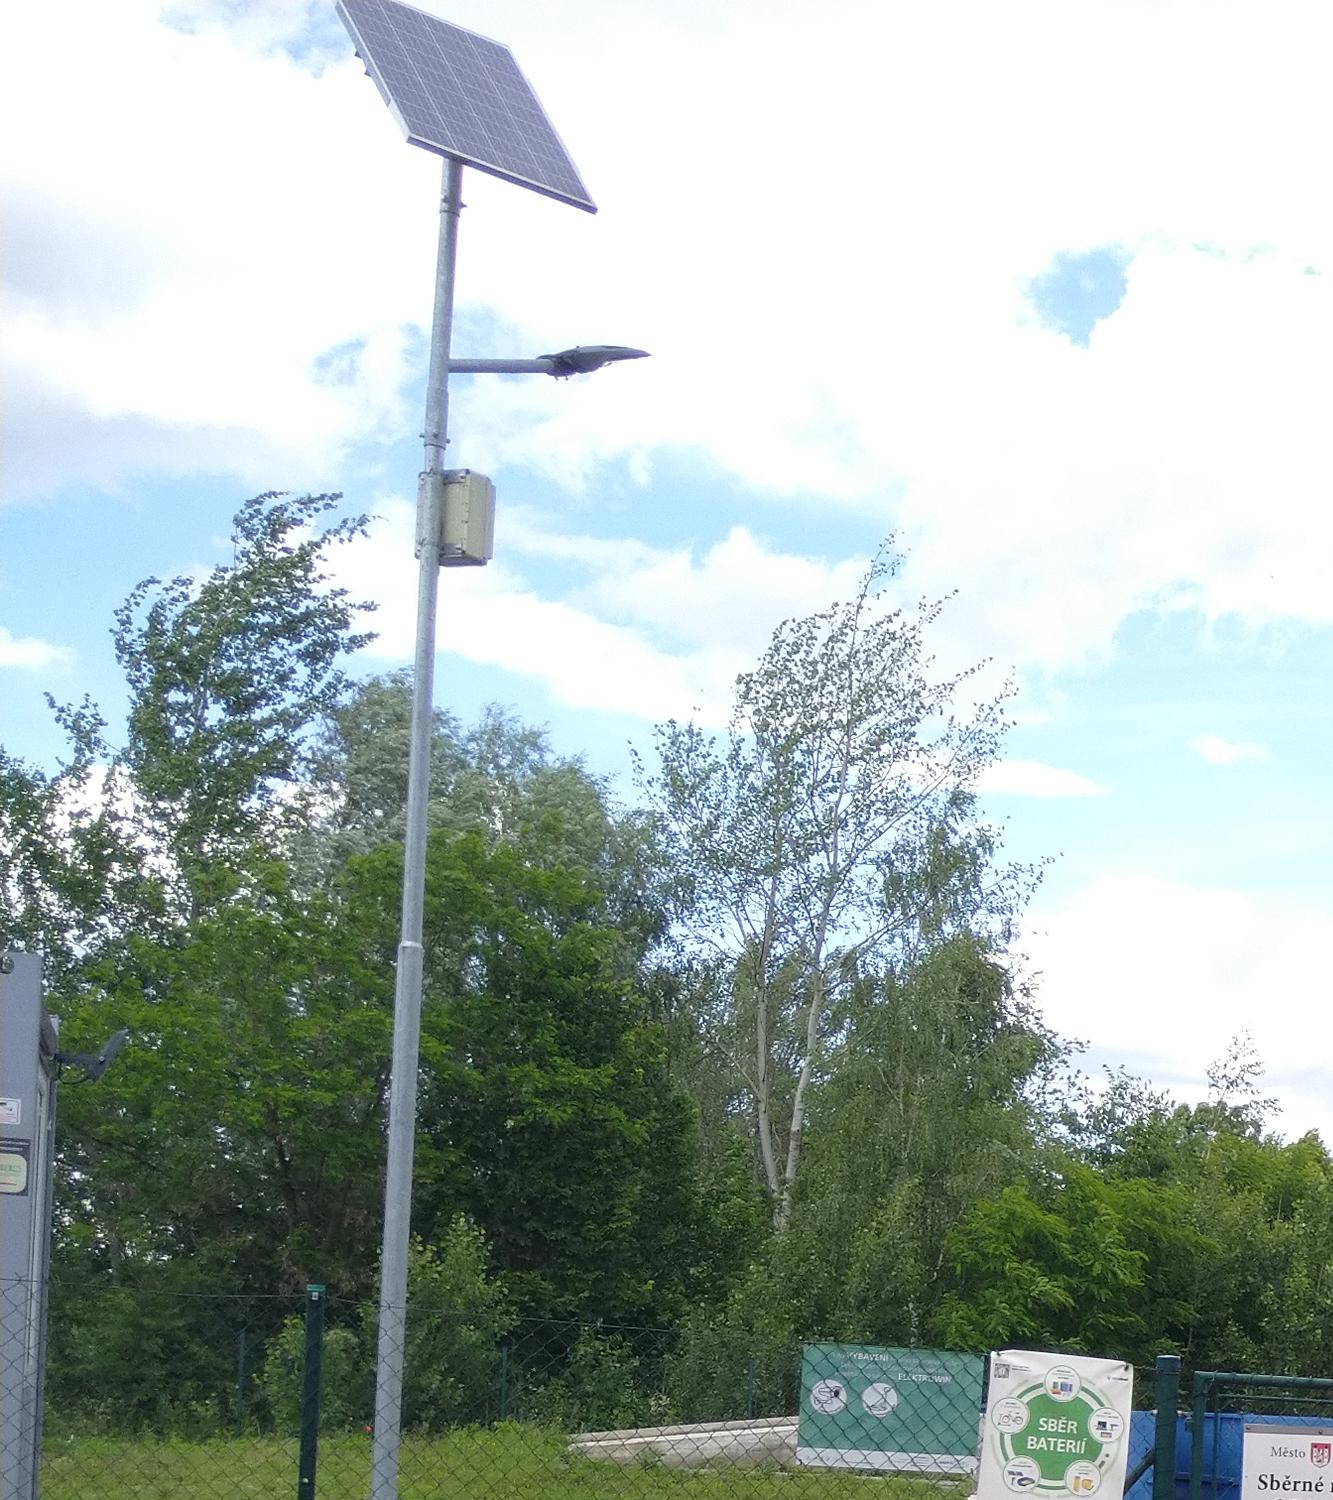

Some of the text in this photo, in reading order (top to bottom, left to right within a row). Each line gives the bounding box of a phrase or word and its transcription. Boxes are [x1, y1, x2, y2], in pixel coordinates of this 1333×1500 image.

[1038, 1416, 1078, 1434] SBĚR
[1026, 1435, 1086, 1454] BATERIÍ
[1270, 1446, 1306, 1458] Město
[1257, 1473, 1324, 1493] Sběrné
